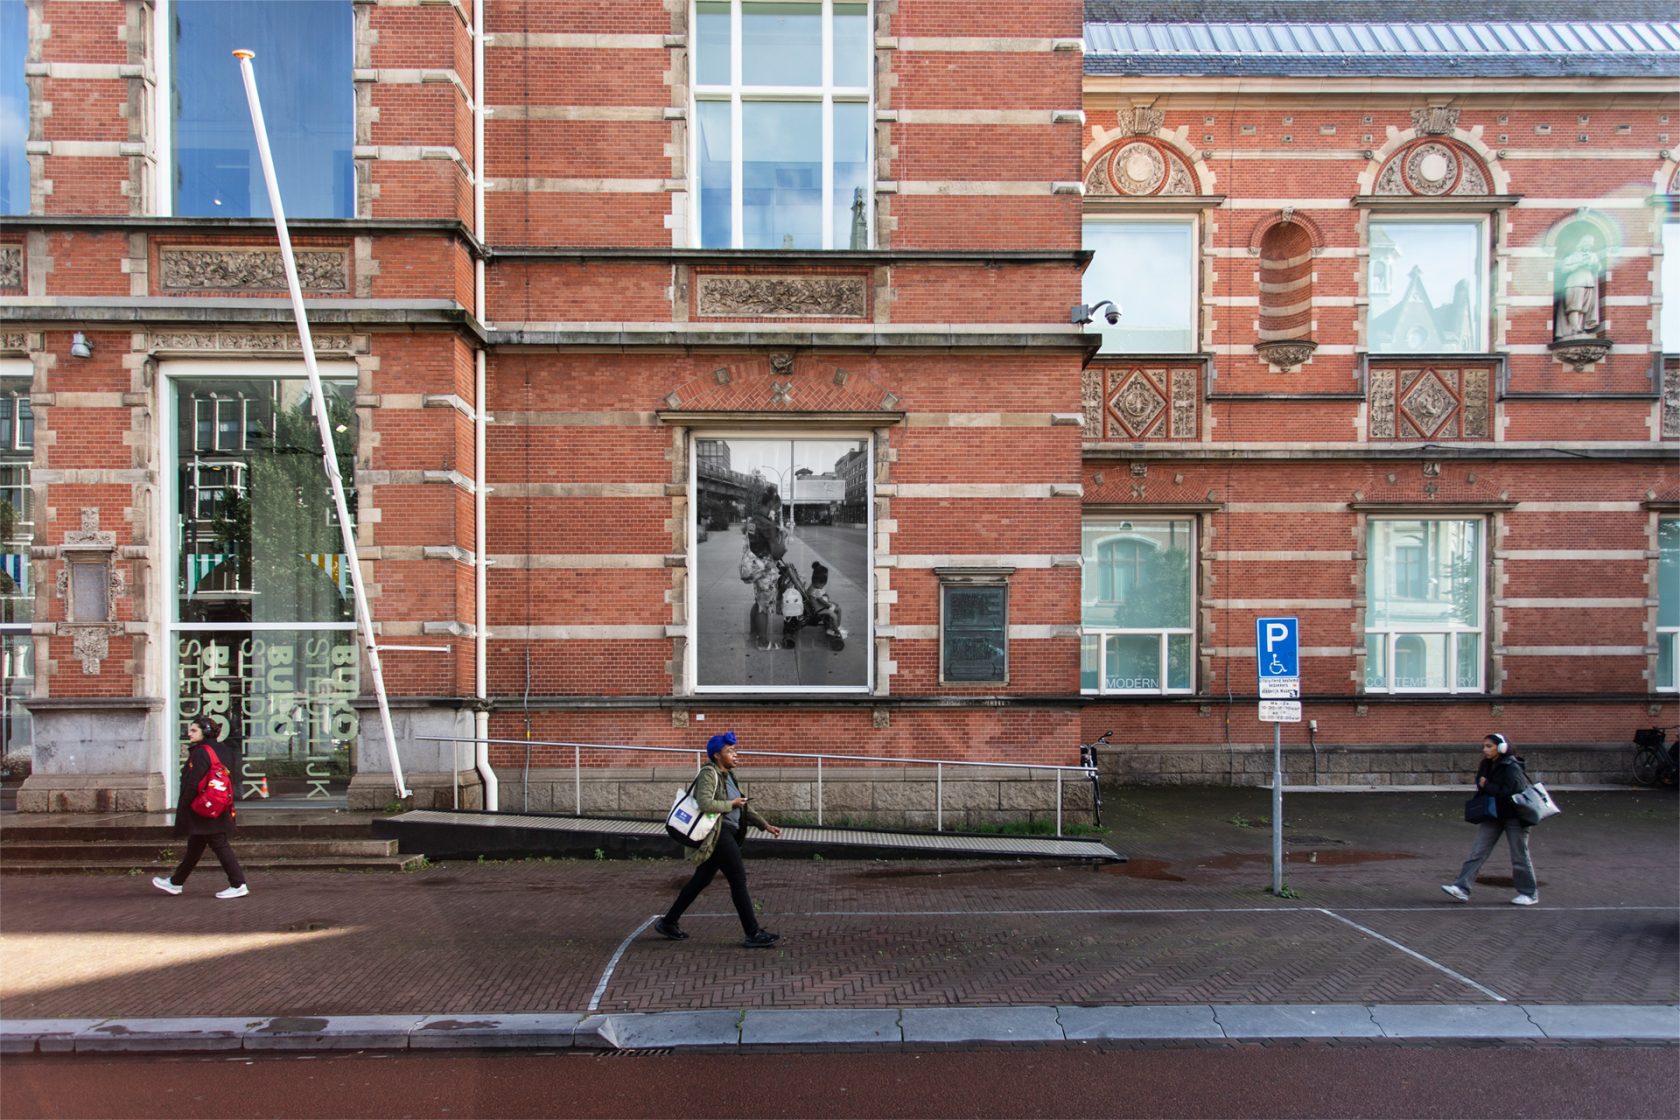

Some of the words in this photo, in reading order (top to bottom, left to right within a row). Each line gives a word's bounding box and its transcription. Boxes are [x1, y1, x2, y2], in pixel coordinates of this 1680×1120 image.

[1106, 678, 1159, 688] MODERN
[1267, 623, 1288, 652] P
[241, 638, 266, 799] STEDELIJK
[305, 638, 330, 798] STEDELIJK
